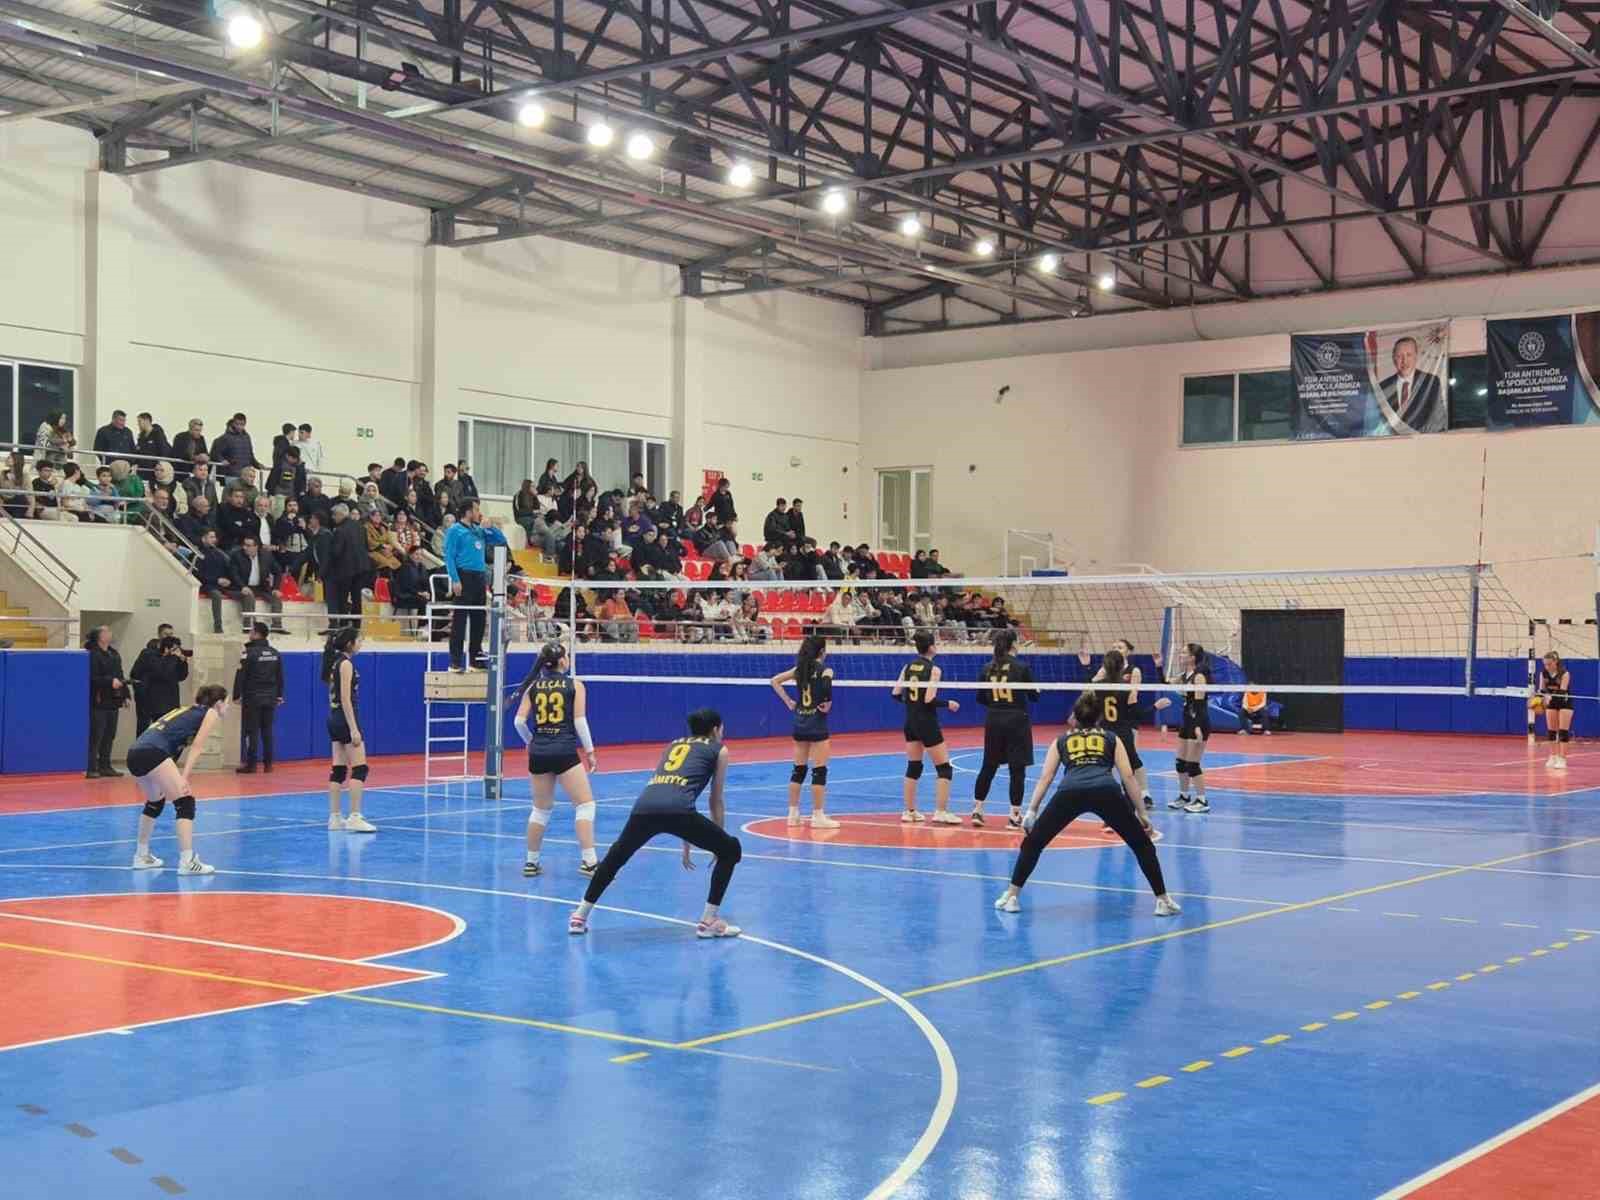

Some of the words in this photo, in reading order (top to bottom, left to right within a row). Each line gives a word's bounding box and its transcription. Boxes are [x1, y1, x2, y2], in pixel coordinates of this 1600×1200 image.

[1521, 367, 1560, 378] ANTRENÖR
[535, 692, 564, 725] 33
[1103, 696, 1118, 722] 6
[664, 743, 691, 772] 9
[1066, 735, 1105, 760] 99
